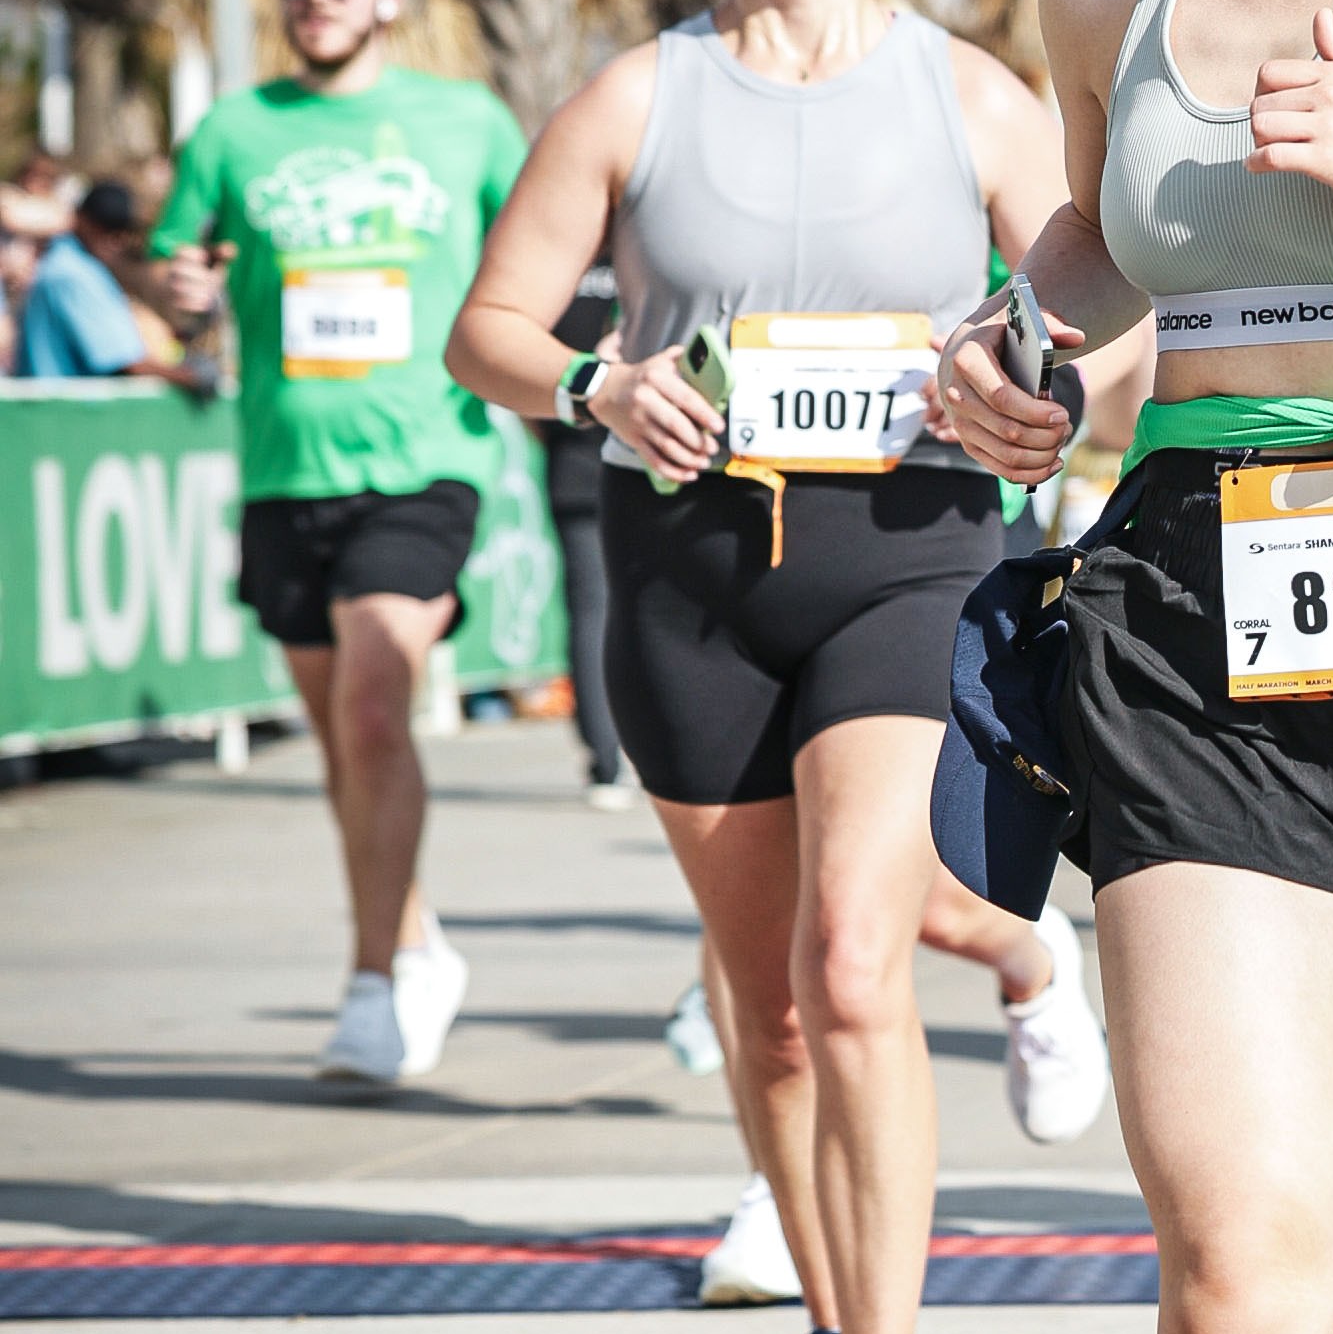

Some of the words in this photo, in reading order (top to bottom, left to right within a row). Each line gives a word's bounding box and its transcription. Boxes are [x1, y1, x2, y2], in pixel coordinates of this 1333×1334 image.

[1240, 307, 1295, 326] new
[769, 389, 897, 432] 10077
[740, 426, 755, 447] 9
[1267, 542, 1301, 552] Sentara
[34, 452, 243, 678] LOVE
[1233, 619, 1271, 629] CORRAL
[1245, 632, 1267, 666] 7
[1257, 681, 1299, 689] MARATHON
[1305, 678, 1332, 686] MARCH
